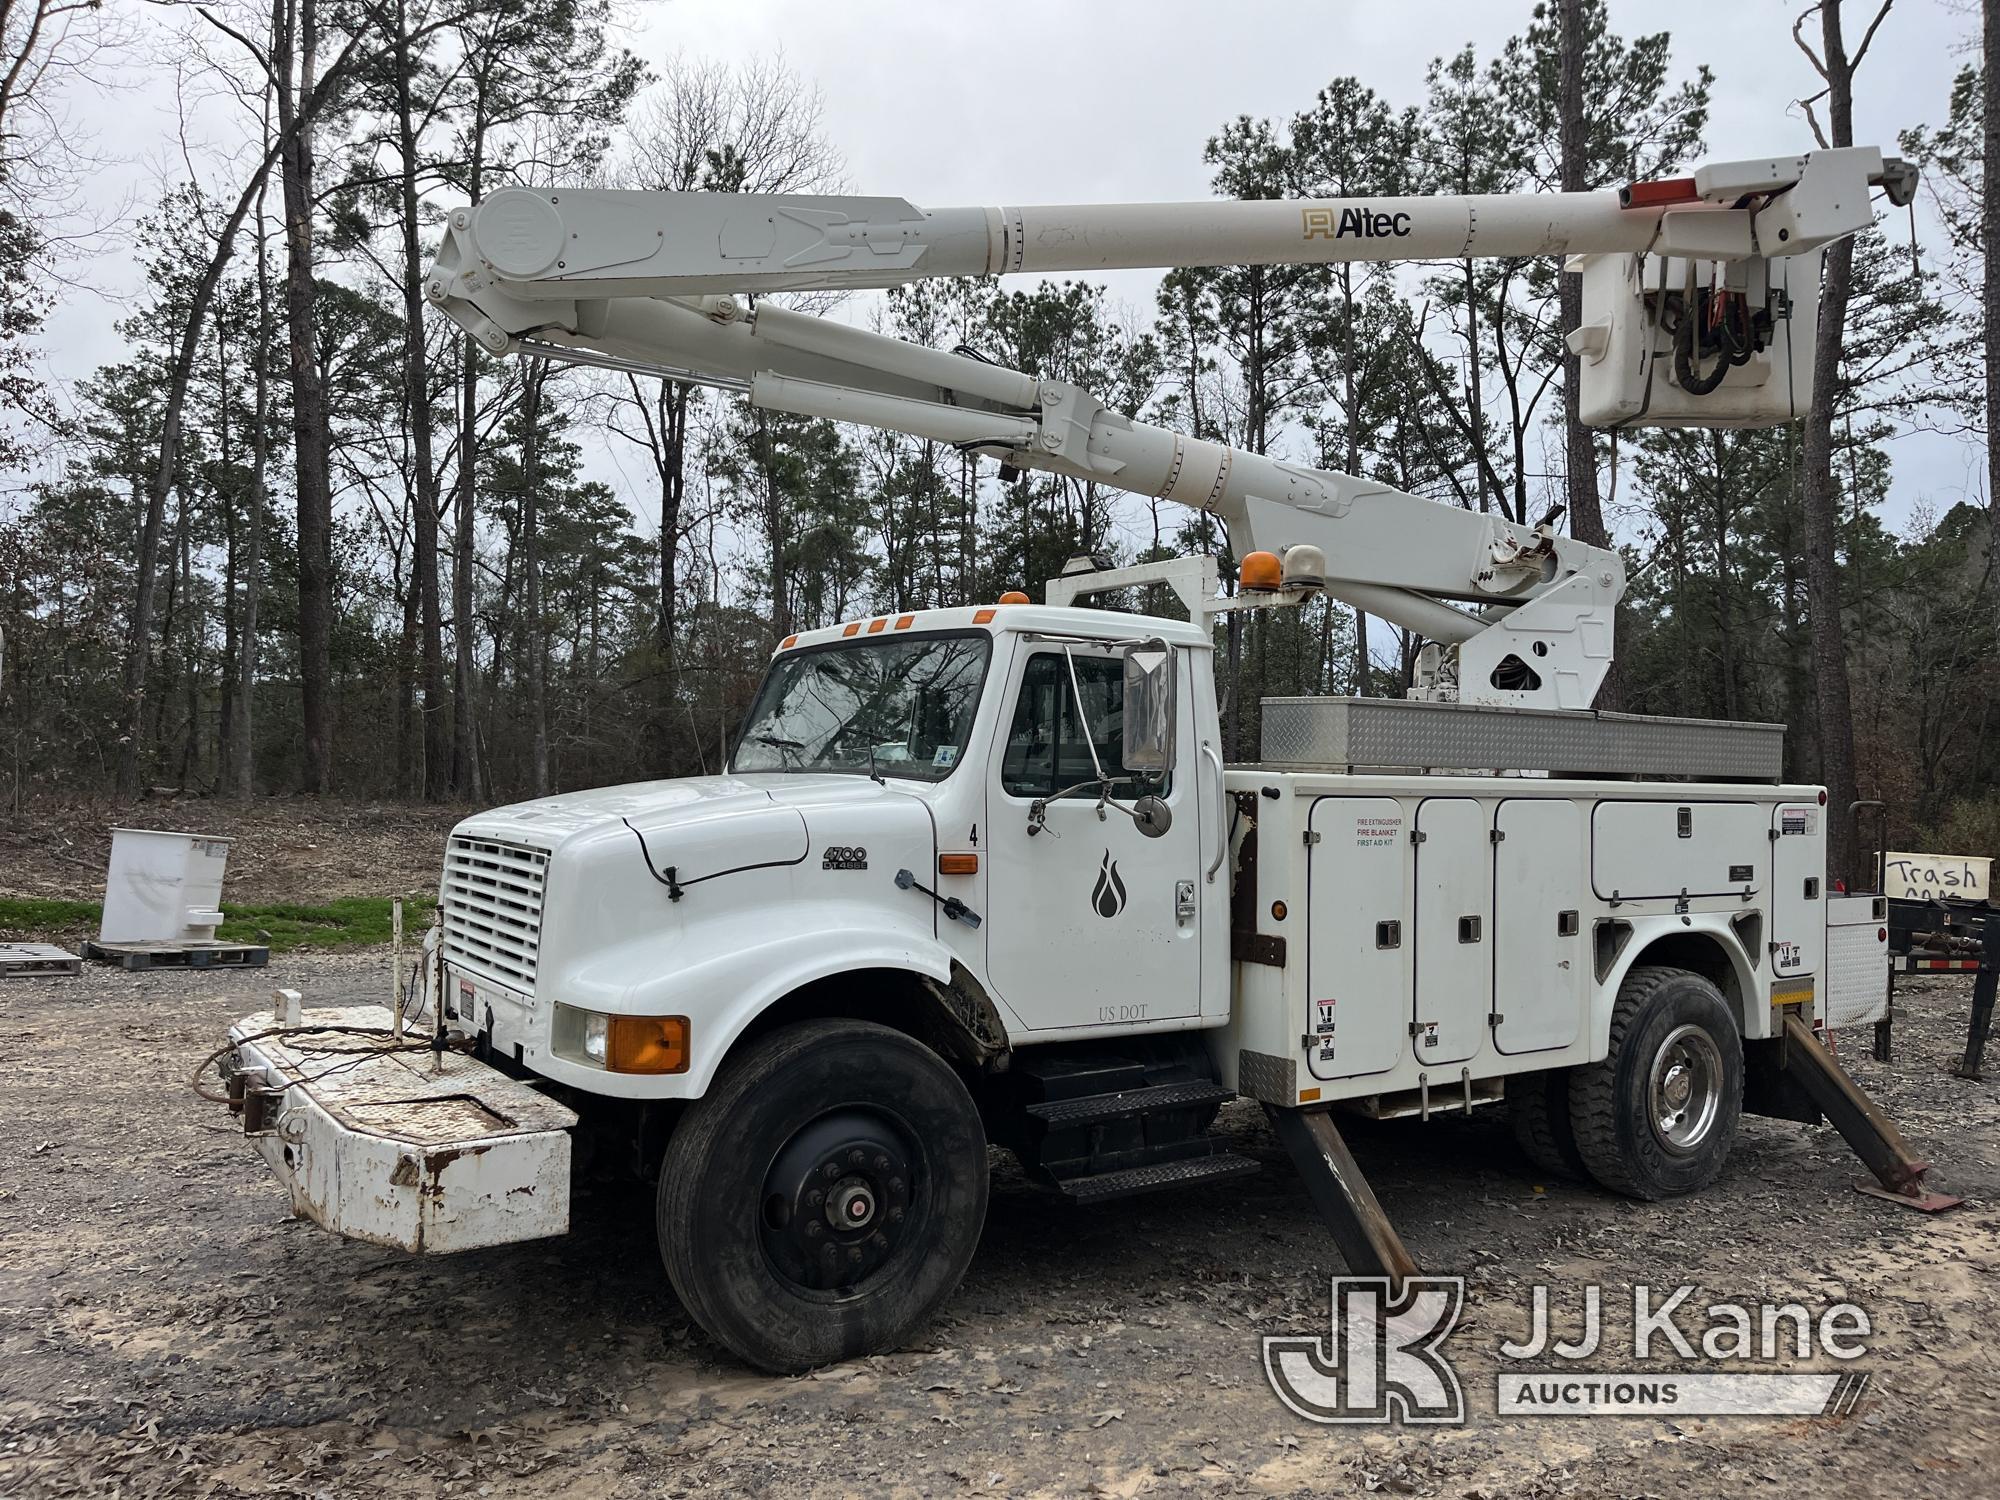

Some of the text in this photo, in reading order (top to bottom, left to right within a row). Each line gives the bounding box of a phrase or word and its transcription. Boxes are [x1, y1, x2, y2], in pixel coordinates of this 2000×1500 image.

[1336, 207, 1411, 238] Altec
[969, 824, 978, 846] 4
[1357, 839, 1372, 847] FIRST
[1373, 839, 1383, 847] AID
[823, 846, 867, 862] 4700
[1887, 860, 1977, 888] Trash
[1099, 1004, 1148, 1022] US DOT
